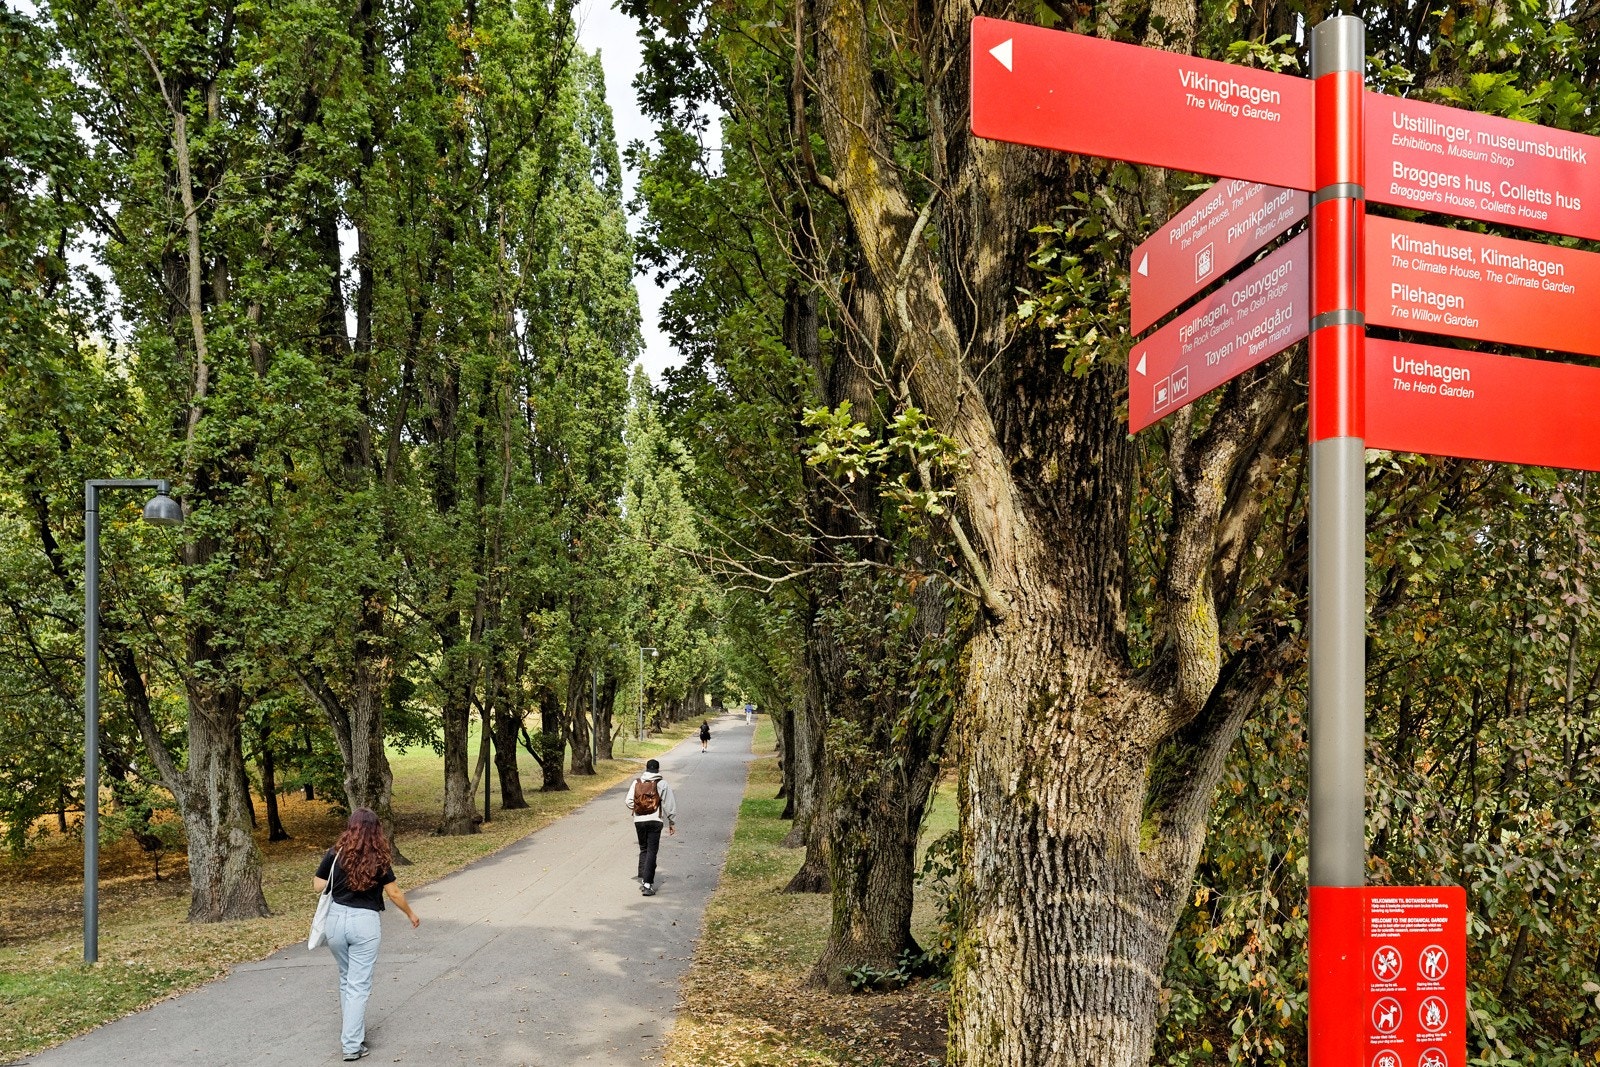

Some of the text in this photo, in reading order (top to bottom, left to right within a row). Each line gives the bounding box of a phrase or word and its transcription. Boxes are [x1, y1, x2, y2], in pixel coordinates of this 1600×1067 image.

[1178, 68, 1281, 105] Vikinghagen
[1185, 93, 1281, 122] The Viking Garden
[1391, 133, 1515, 168] Exhibitions, Museum Shop
[1392, 111, 1587, 165] Utstillinger, museumsbutikk
[1390, 182, 1548, 220] Brøggger's House, Collett's House
[1392, 161, 1581, 211] Brøggers hus, Colletts hus
[1169, 192, 1225, 245] Palmehuset,
[1181, 235, 1192, 251] The
[1192, 227, 1207, 245] Palm
[1208, 207, 1230, 231] House,
[1231, 195, 1244, 212] The
[1227, 188, 1294, 244] Piknikplenen
[1255, 205, 1294, 240] Picnic Area
[1391, 232, 1565, 277] Klimahuset, Klimahagen
[1391, 254, 1575, 294] The Climate House, The Climate Garden
[1179, 259, 1293, 343] Fjellhagen, Osloryggen
[1391, 282, 1465, 311] Pilehagen
[1182, 281, 1289, 356] The Rock Garden, The Oslo Ridge
[1204, 301, 1294, 367] Tøyen hovedgård
[1411, 307, 1442, 323] Willow
[1443, 312, 1479, 329] Garden
[1247, 323, 1293, 357] Tøyen manor
[1172, 376, 1188, 395] WC
[1392, 355, 1471, 383] Urtehagen
[1392, 377, 1475, 399] The Herb Garden
